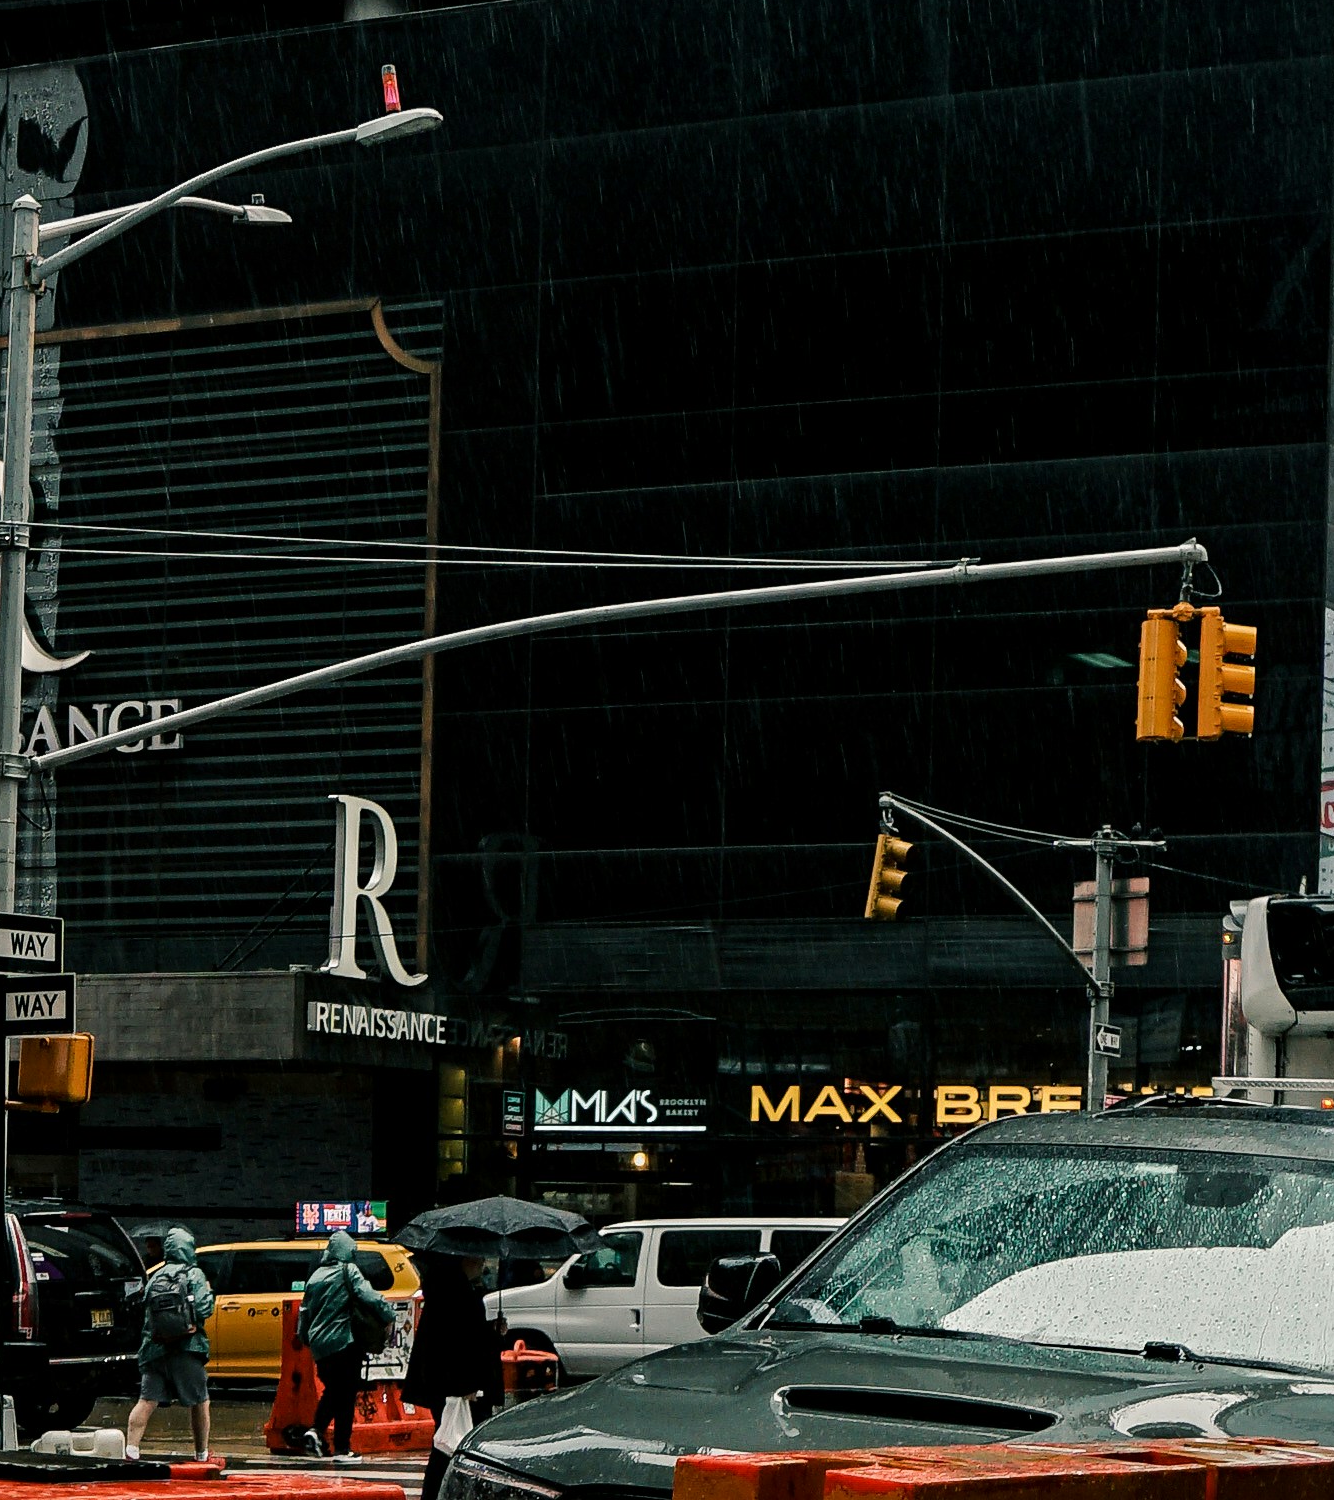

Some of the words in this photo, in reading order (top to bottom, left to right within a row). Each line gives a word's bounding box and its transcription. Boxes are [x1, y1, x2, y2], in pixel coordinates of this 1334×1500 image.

[317, 795, 428, 986] R
[11, 932, 49, 958] WAY
[14, 993, 59, 1019] WAY
[313, 1001, 448, 1045] RENAISSANCE
[571, 1088, 658, 1123] MIA'S
[659, 1097, 707, 1106] BROOKLYN
[665, 1108, 699, 1117] BAKERY
[750, 1085, 903, 1123] MAX
